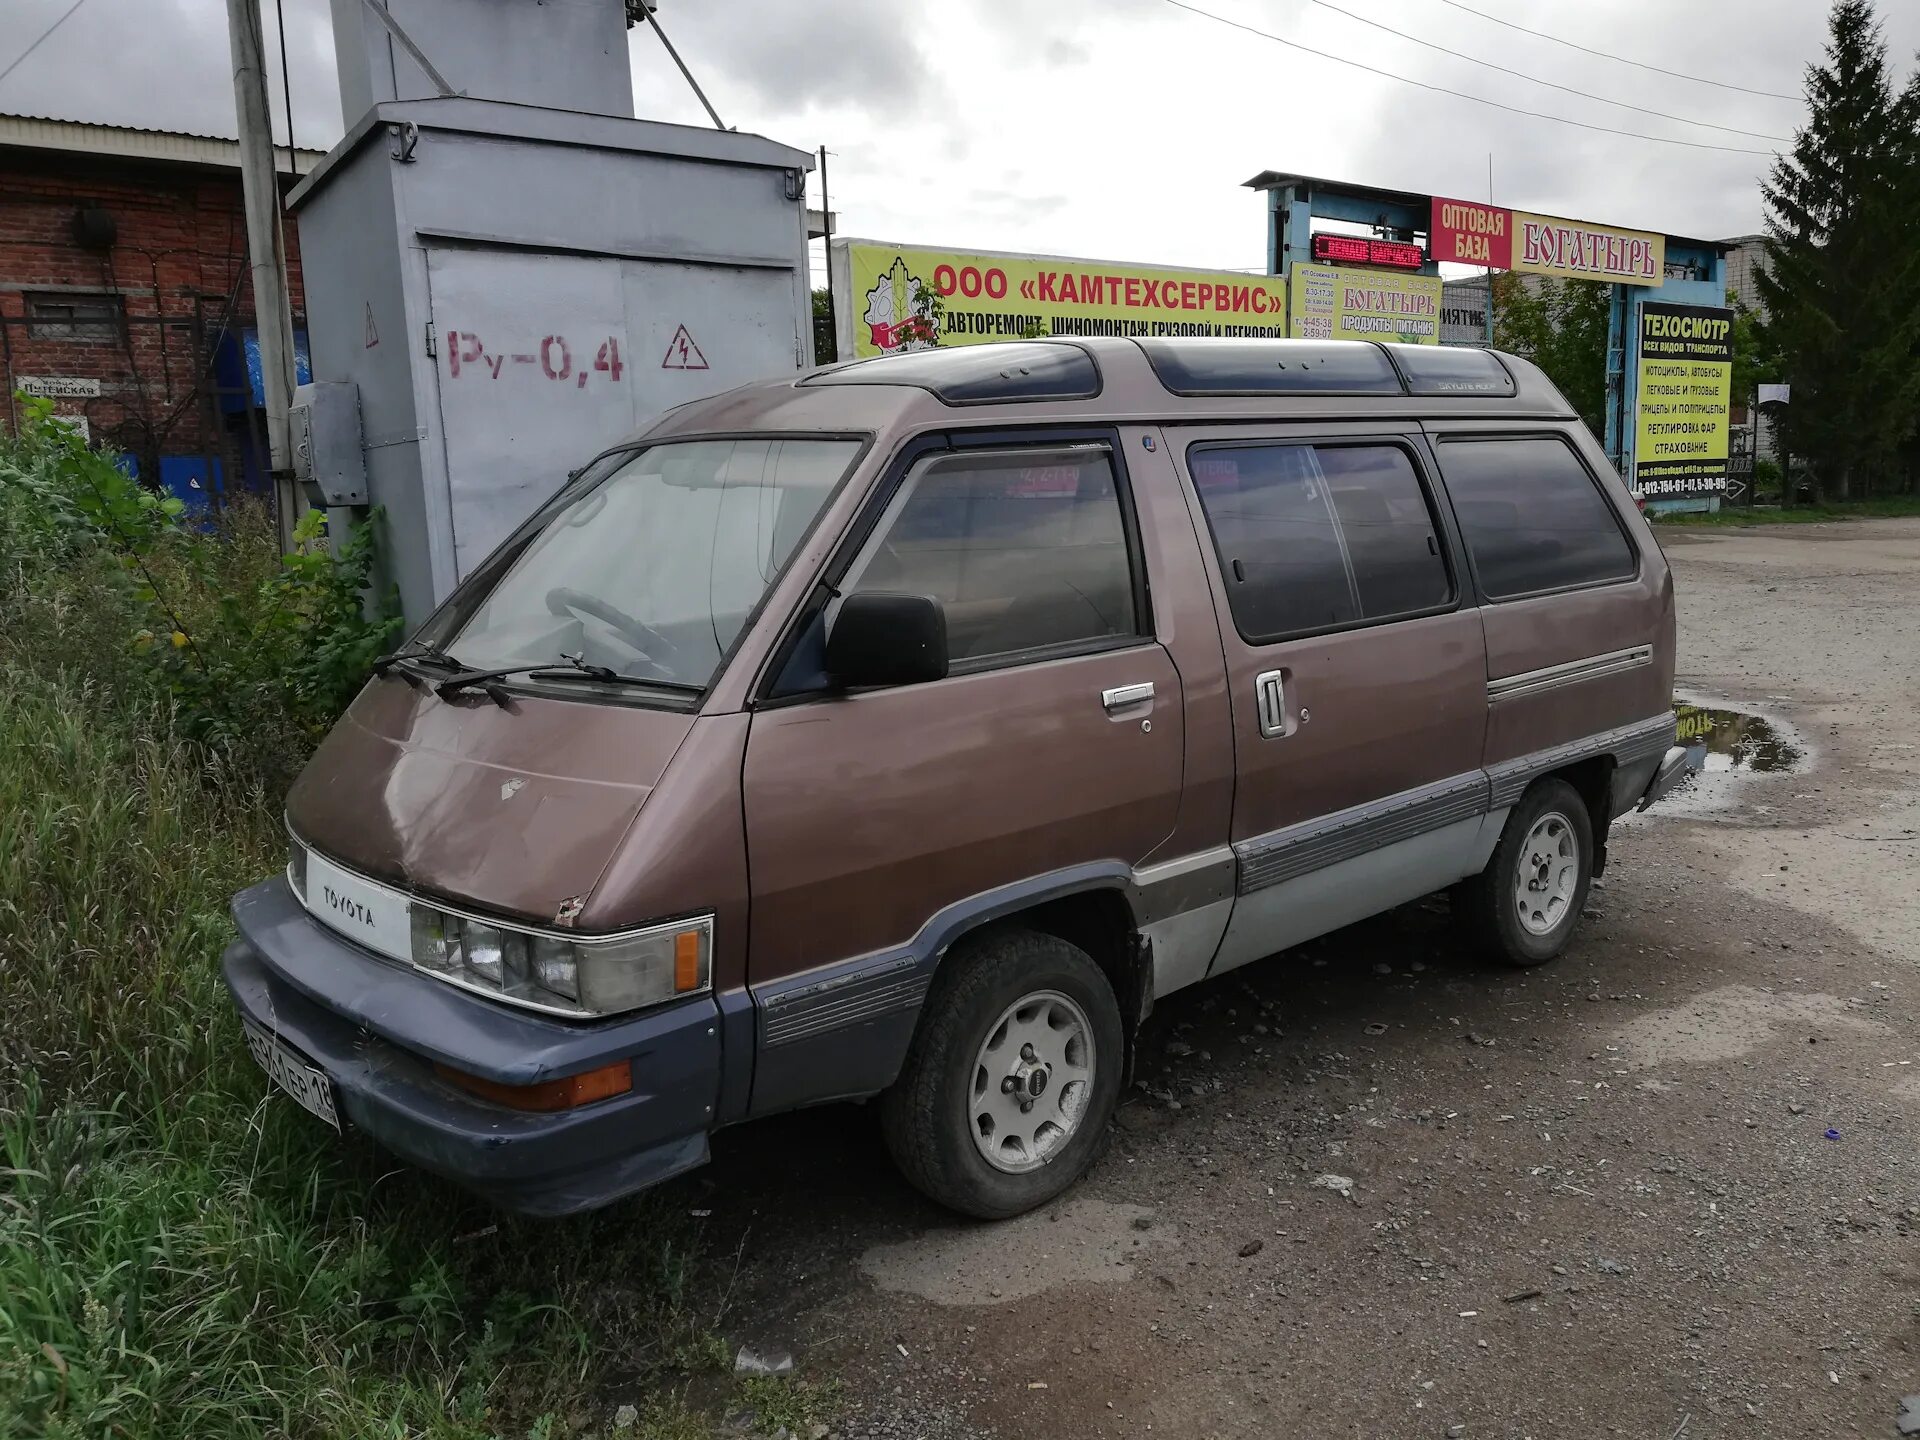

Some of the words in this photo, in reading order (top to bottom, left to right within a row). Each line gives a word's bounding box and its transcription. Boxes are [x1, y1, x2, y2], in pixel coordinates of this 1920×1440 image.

[1442, 204, 1504, 237] ОПТОВАЯ
[1455, 234, 1490, 261] БАЗА
[1522, 222, 1656, 278] БОГАТЫРЬ
[934, 264, 1008, 299] ООО
[1020, 271, 1281, 314] «КАМТЕХСЕРВИС»
[1344, 274, 1400, 288] ОПТОВАЯ
[1408, 281, 1437, 292] БАЗА
[1343, 288, 1436, 317] БОГАТЫРЬ
[948, 311, 1042, 336] АВТОРЕМОНТ
[1051, 317, 1148, 337] ШИНОМОНТАЖ
[1152, 320, 1212, 337] ГРУЗОВОЙ
[1214, 323, 1222, 337] И
[1303, 328, 1331, 339] 2-59-07
[1341, 315, 1393, 334] ПРОДУКТЫ
[1396, 319, 1434, 335] ПИТАНИЯ
[1644, 313, 1730, 341] ТЕХОСМОТР
[1643, 340, 1659, 351] ВСЕХ
[1660, 341, 1684, 354] ВИДОВ
[1686, 342, 1728, 355] ТРАНСПОРТА
[1645, 365, 1690, 378] МОТОЦИКЛЫ,
[1691, 367, 1723, 378] АВТОБУСЫ
[1646, 384, 1680, 395] ЛЕГКОВЫЕ
[1682, 385, 1688, 395] И
[1690, 385, 1719, 396] ГРУЗОВЫЕ
[1641, 404, 1670, 416] ПРИЦЕПЫ
[1672, 404, 1677, 414] И
[1679, 403, 1726, 415] ПОЛУПРИЦЕПЫ
[1647, 422, 1699, 435] РЕГУЛИРОВКА
[1701, 423, 1716, 434] ФАР
[1654, 442, 1708, 454] СТРАХОВАНИЕ
[323, 886, 376, 928] TOYOTA
